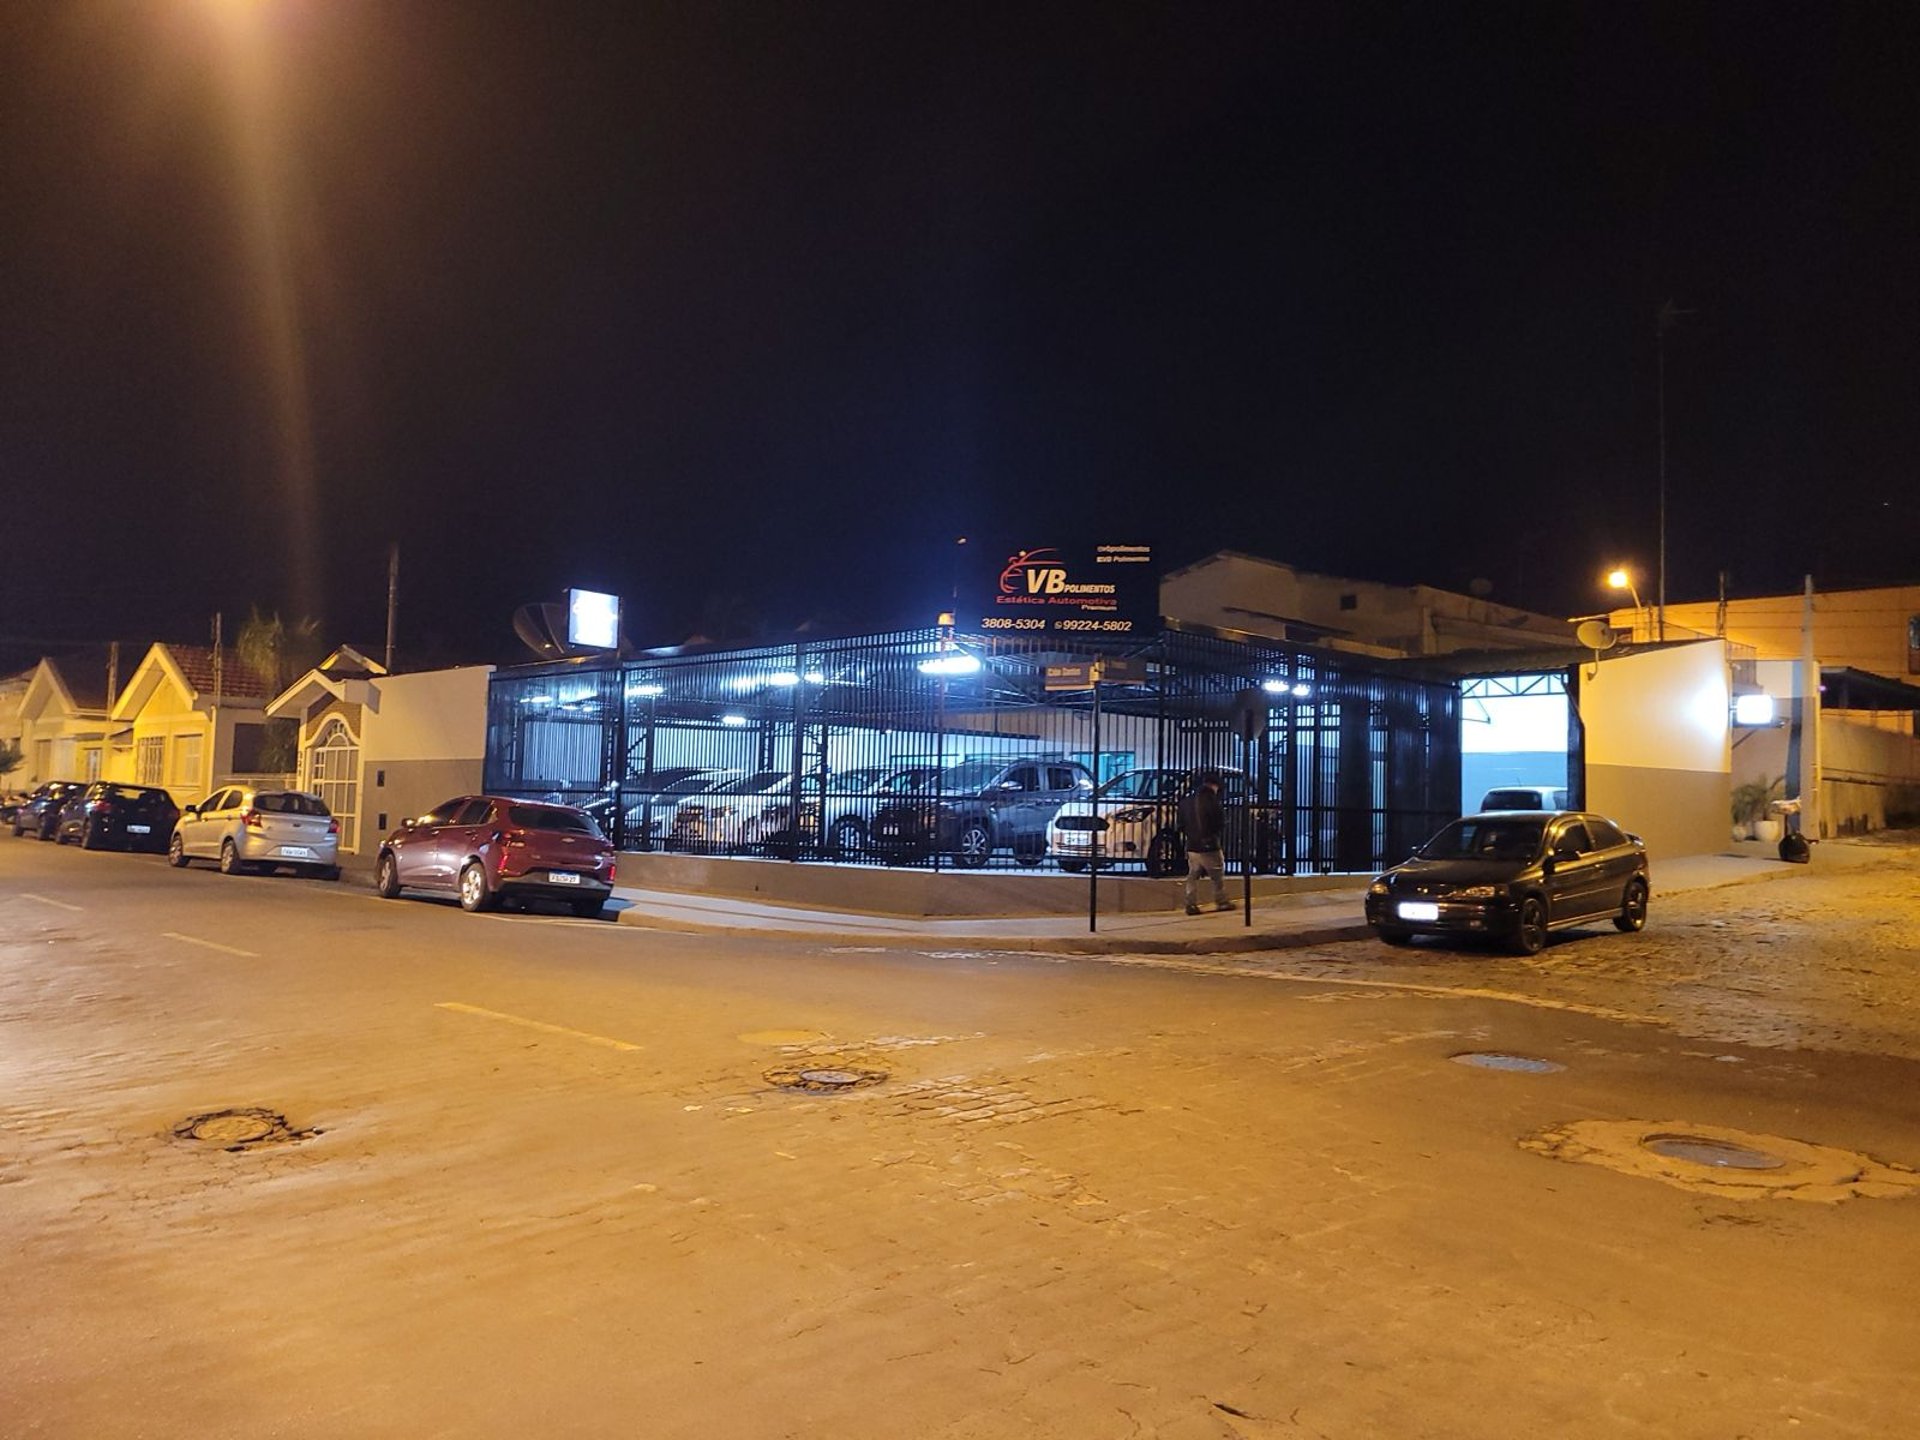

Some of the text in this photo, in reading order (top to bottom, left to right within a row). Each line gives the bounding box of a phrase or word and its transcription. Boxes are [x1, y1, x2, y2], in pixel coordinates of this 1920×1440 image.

[1026, 569, 1116, 594] VB POLIMENTOS
[996, 594, 1118, 606] Estética Automotiva
[981, 618, 1133, 631] 3808-5304 99224-5802
